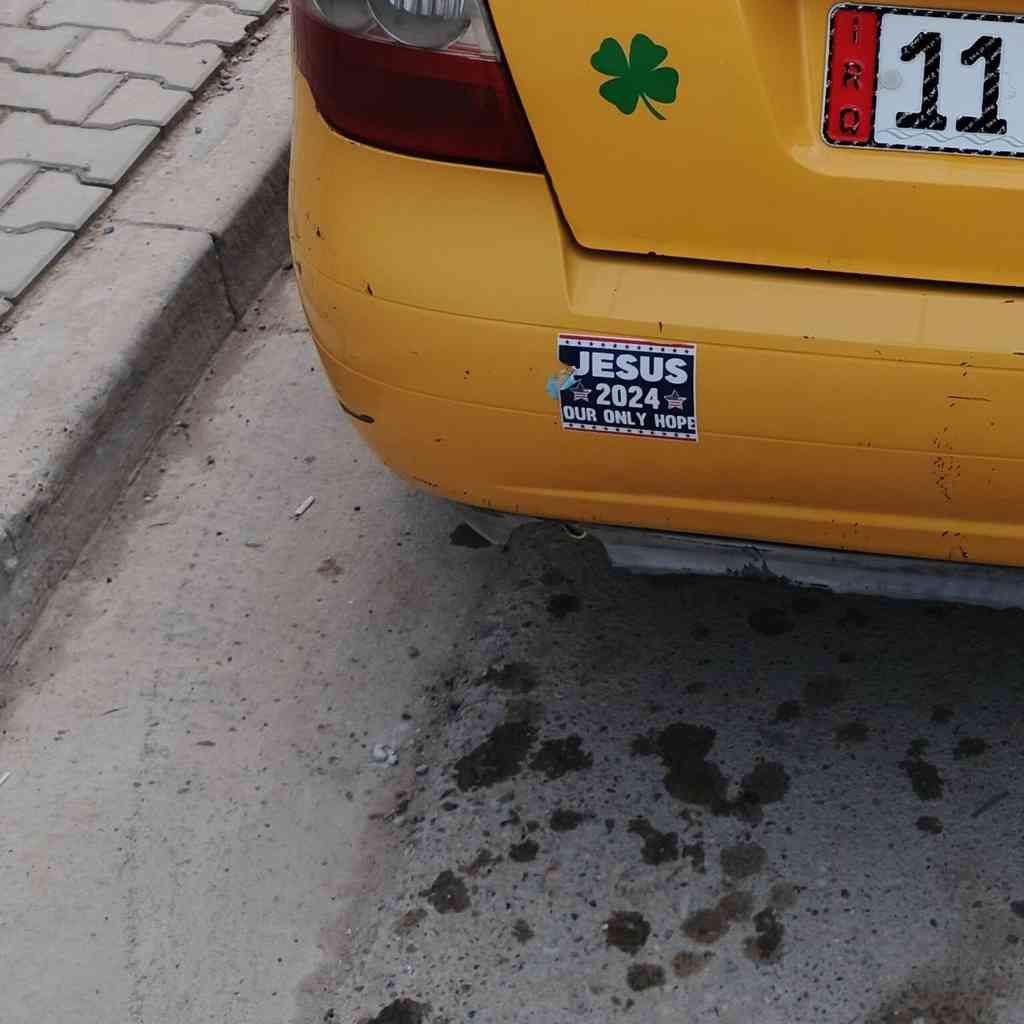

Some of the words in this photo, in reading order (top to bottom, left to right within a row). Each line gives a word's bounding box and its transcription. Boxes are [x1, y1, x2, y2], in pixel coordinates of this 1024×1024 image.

[840, 16, 862, 135] IRQ
[896, 31, 1008, 135] 11
[573, 350, 689, 385] JESUS
[595, 383, 661, 410] 2024
[563, 405, 597, 422] OUR
[603, 408, 648, 426] ONLY
[654, 413, 697, 430] HOPE
